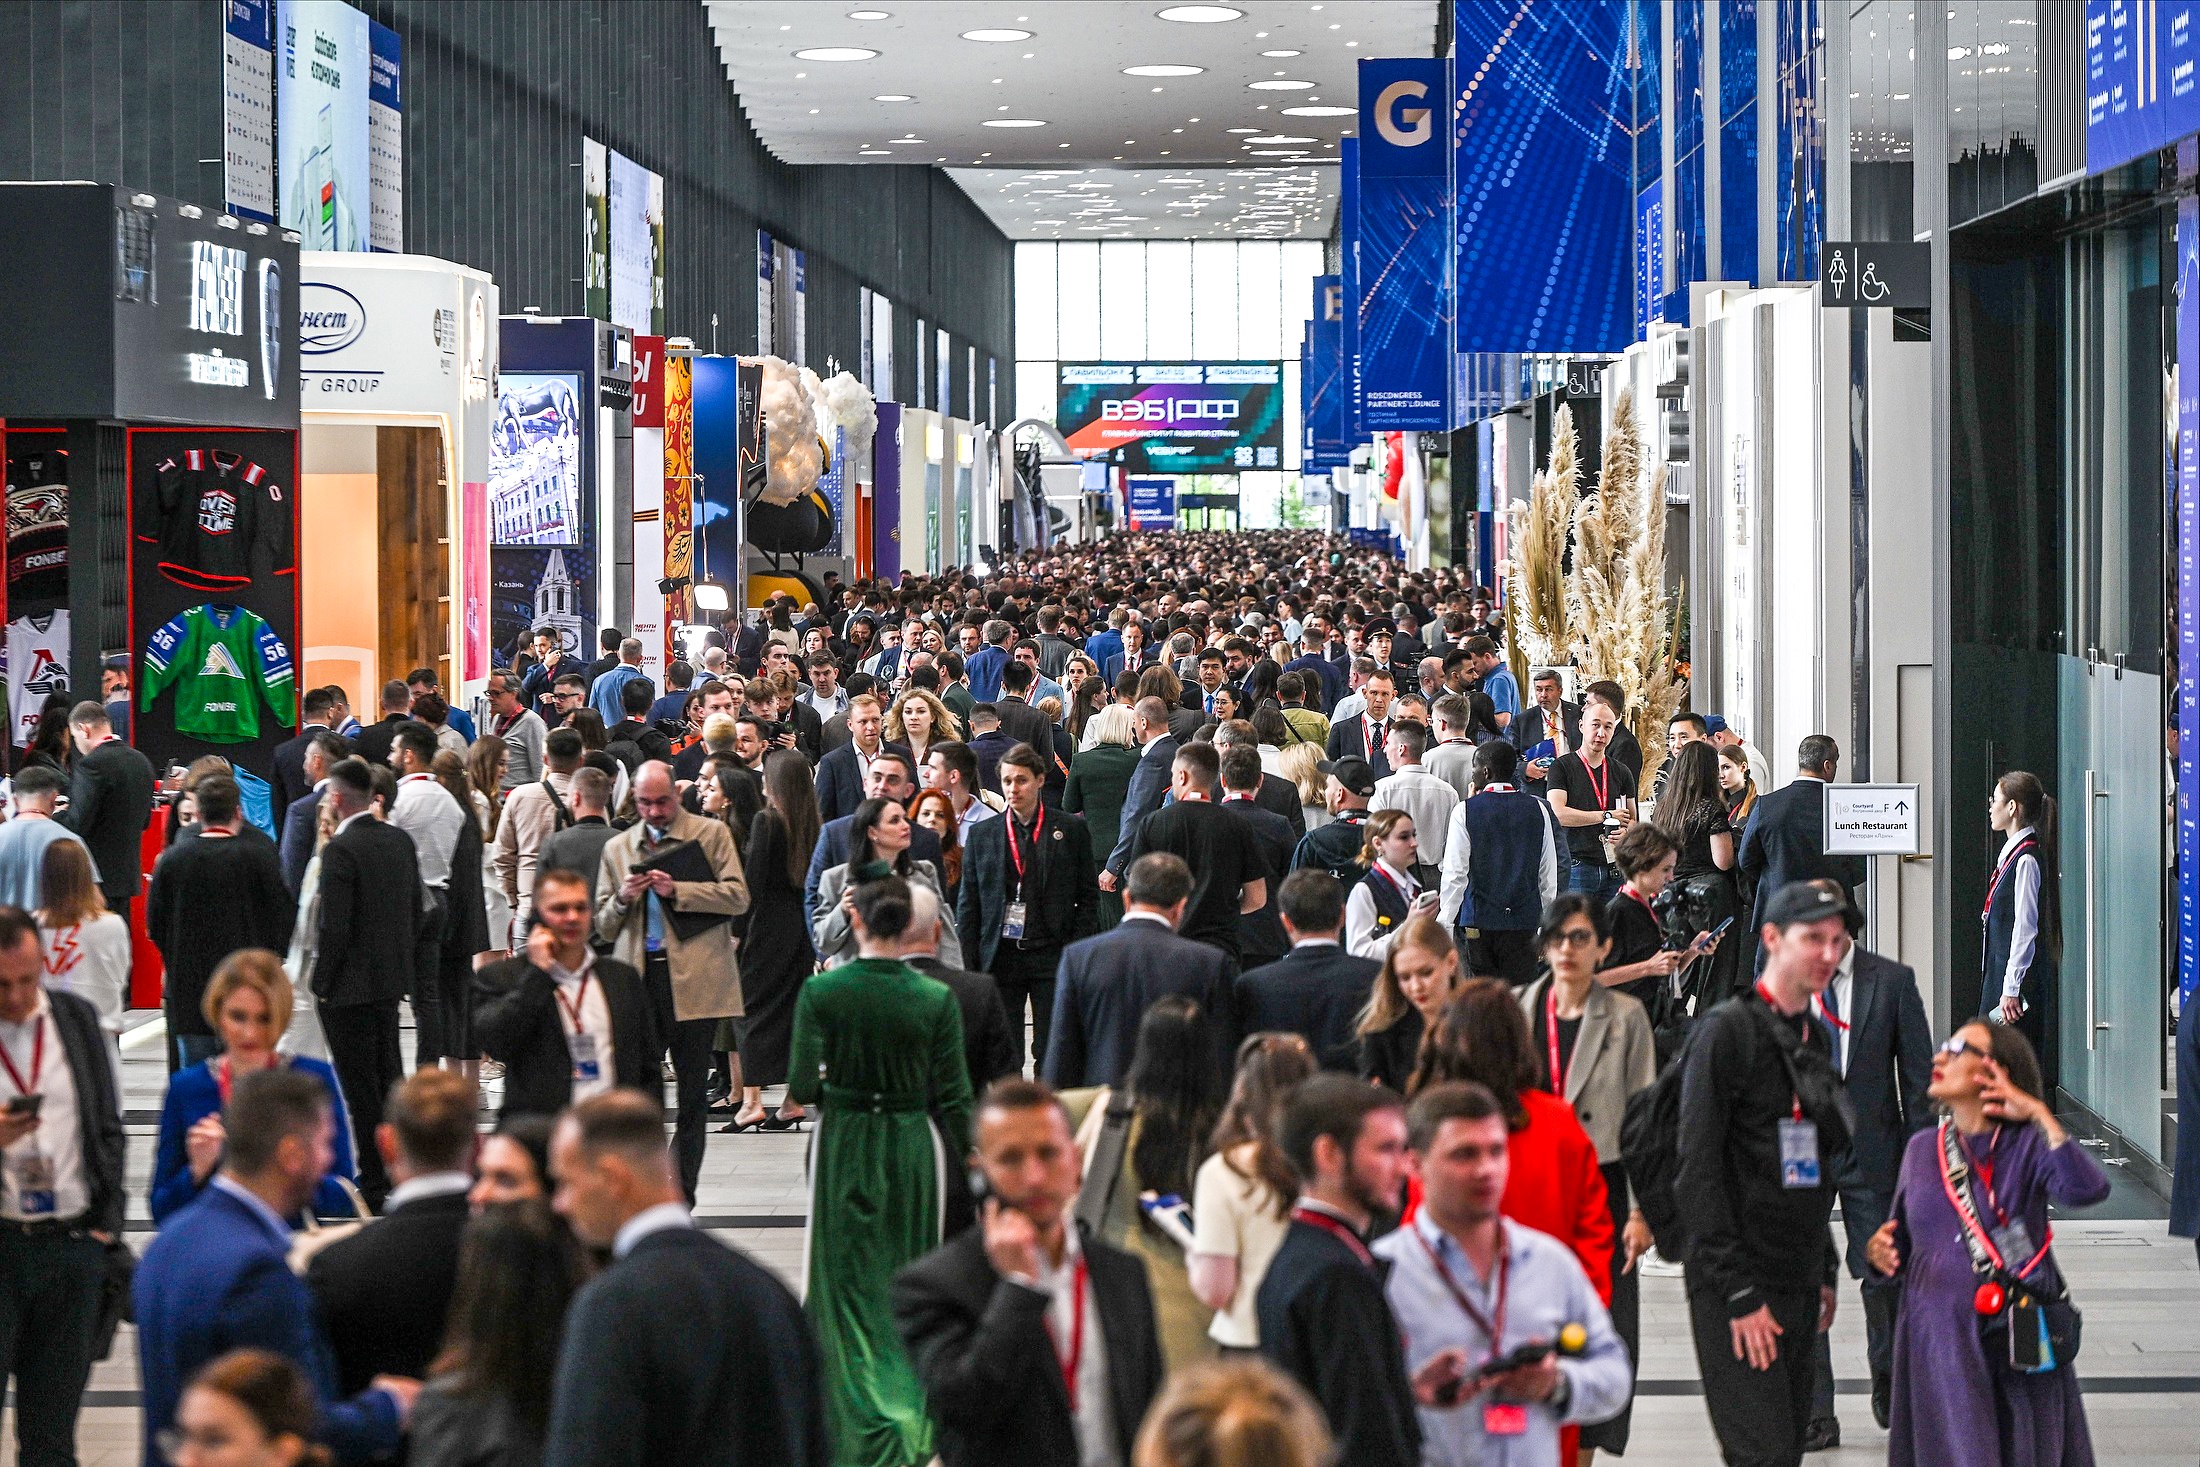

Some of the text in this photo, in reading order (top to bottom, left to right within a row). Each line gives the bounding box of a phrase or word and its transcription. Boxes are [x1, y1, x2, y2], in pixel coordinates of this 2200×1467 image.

[1373, 80, 1433, 148] G
[300, 311, 347, 328] нест
[321, 378, 380, 393] GROUP
[1366, 391, 1423, 399] ROSCONGRESS
[1409, 400, 1441, 408] LOUNGE
[199, 496, 237, 516] OVER
[198, 513, 235, 532] TIME
[151, 627, 176, 651] 56
[263, 642, 289, 662] 56
[1884, 803, 1890, 813] F
[1835, 821, 1908, 830] Lunch Restaurant
